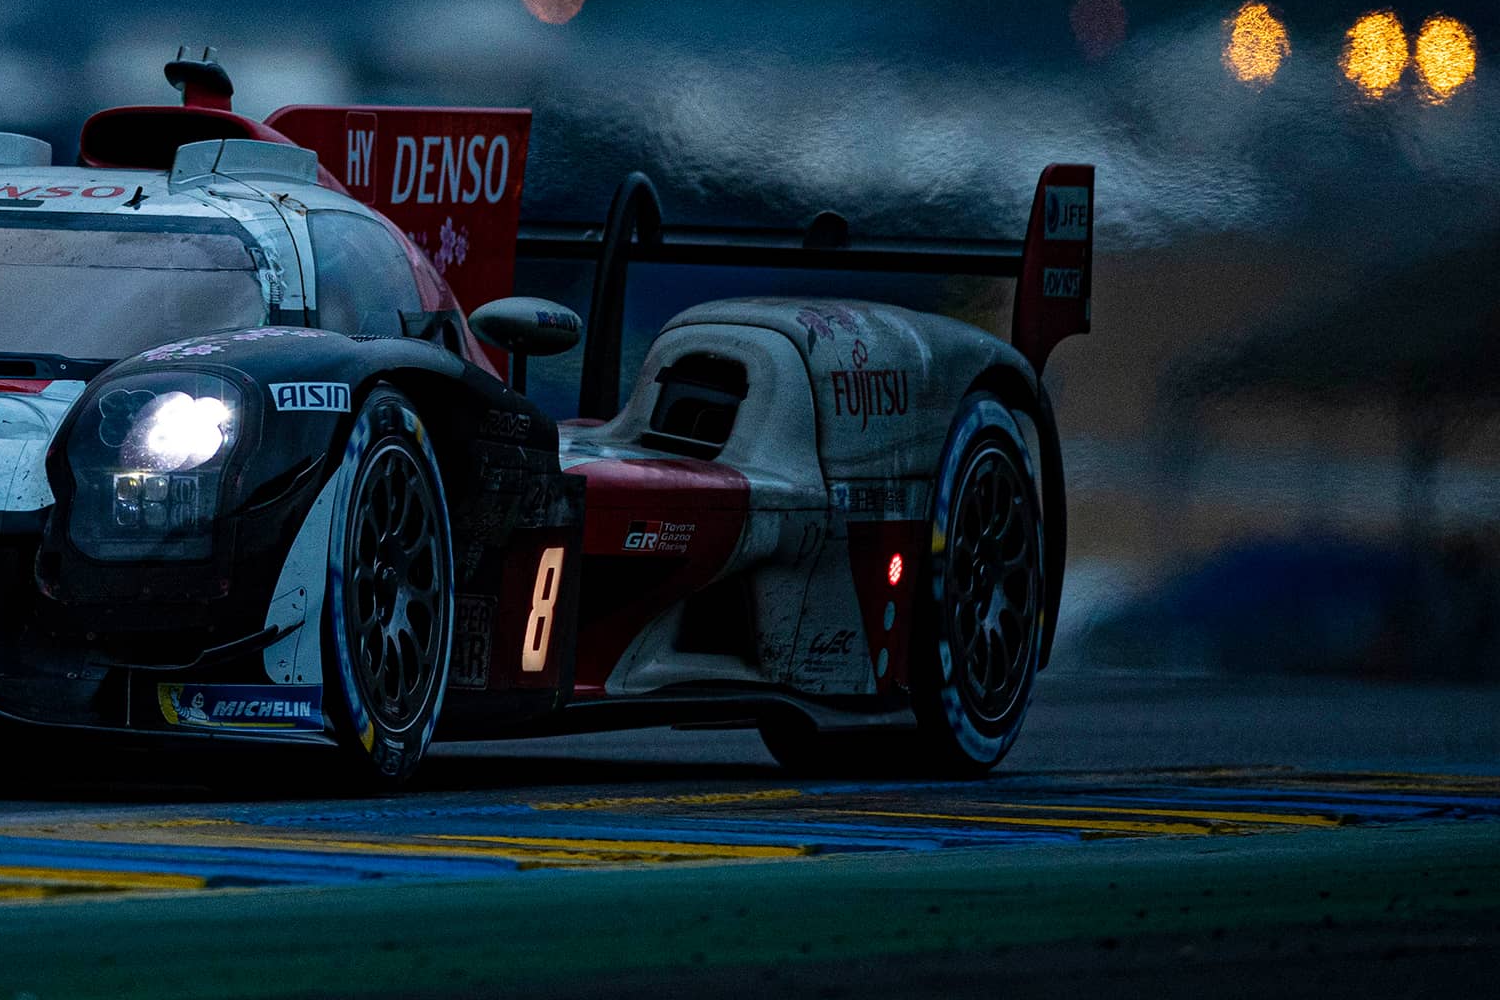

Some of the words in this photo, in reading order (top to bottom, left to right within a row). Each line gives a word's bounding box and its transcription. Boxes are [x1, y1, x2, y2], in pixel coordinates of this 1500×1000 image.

[347, 129, 374, 187] HY
[390, 134, 511, 205] DENSO
[1060, 204, 1087, 227] JFE
[278, 385, 349, 409] AISIN
[831, 370, 909, 433] FUJITSU
[624, 532, 659, 549] GR
[521, 546, 565, 672] 8
[211, 700, 312, 718] MICHELIN
